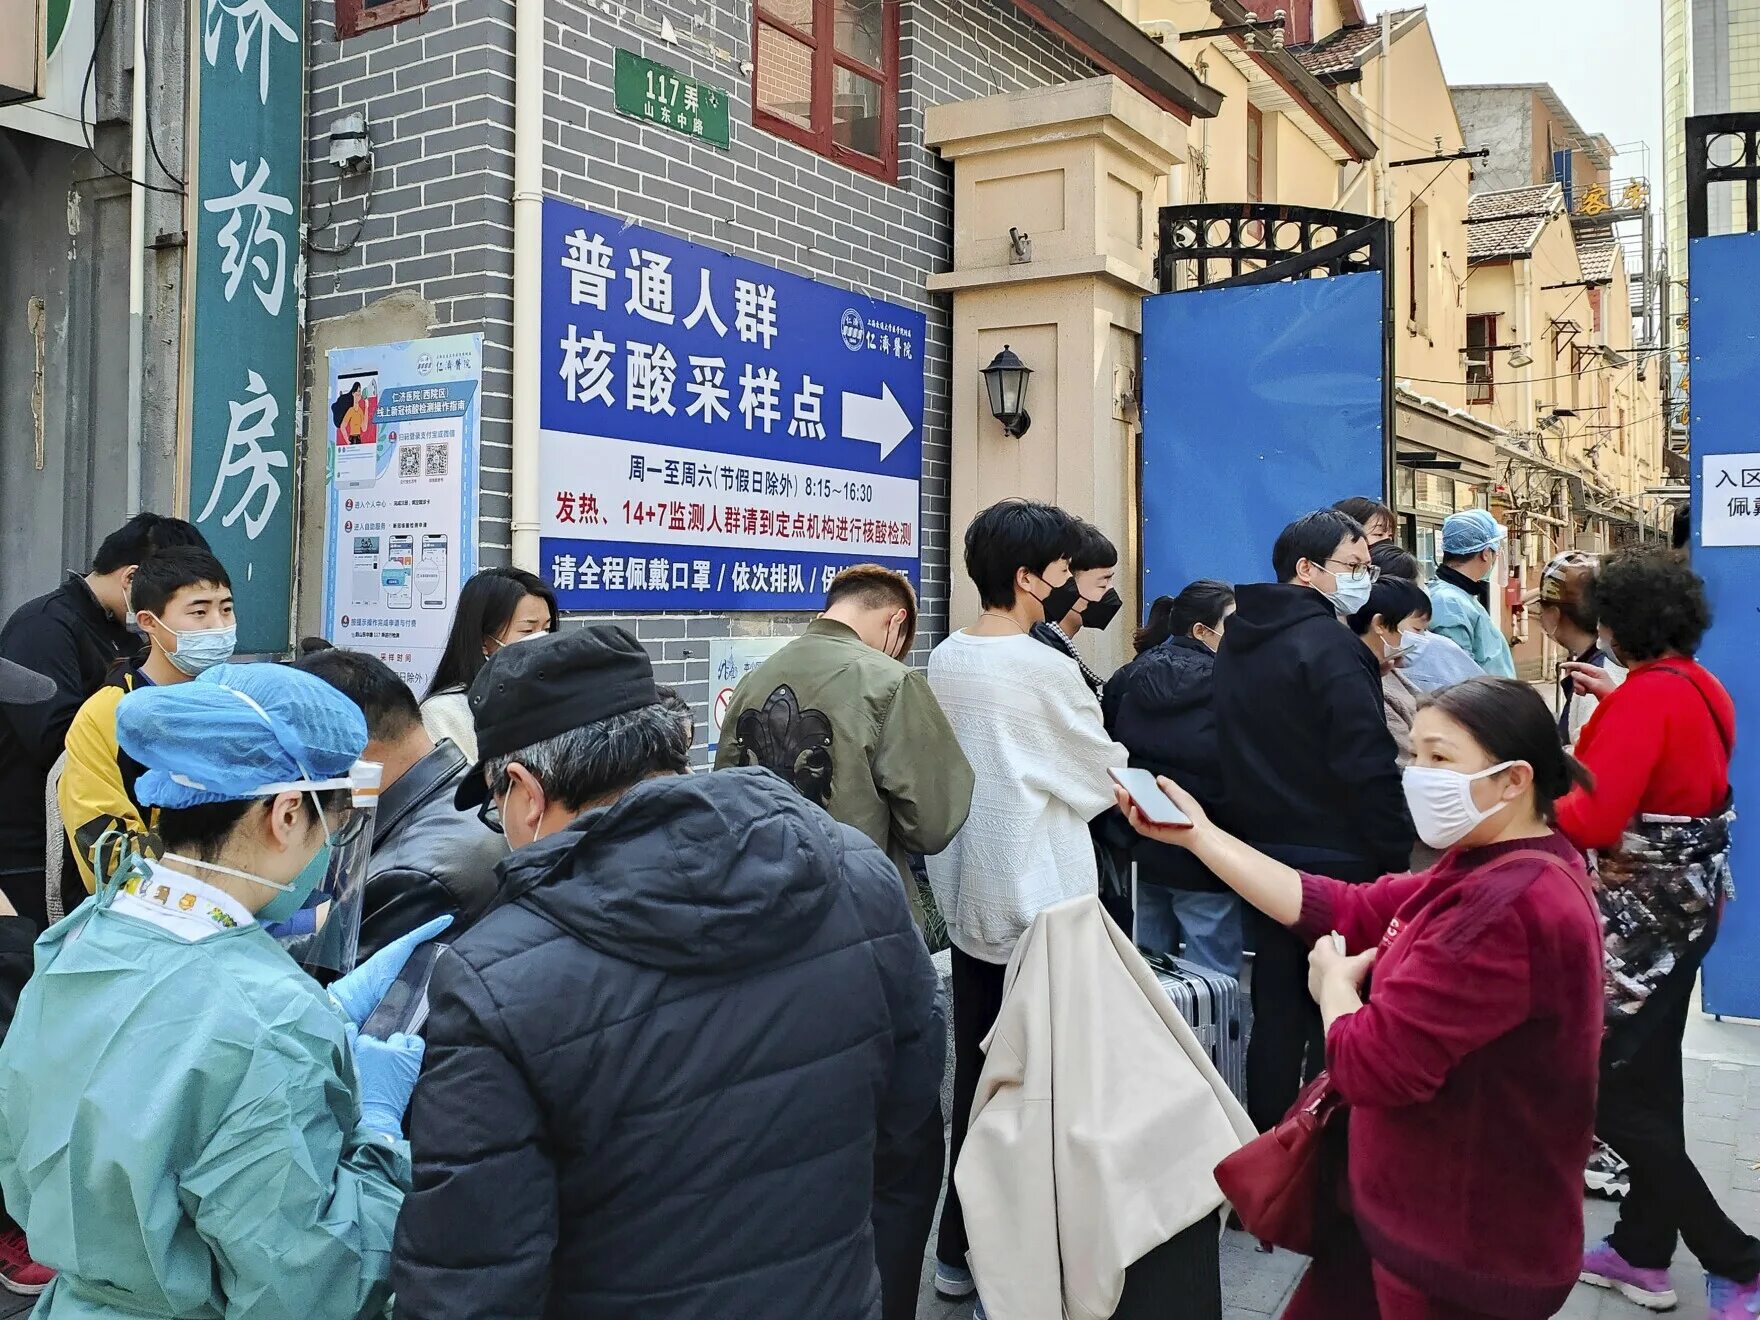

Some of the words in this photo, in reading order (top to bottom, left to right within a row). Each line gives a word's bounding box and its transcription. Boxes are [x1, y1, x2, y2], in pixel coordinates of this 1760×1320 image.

[646, 70, 699, 113] 117弄
[644, 100, 704, 135] 山东中路
[561, 229, 778, 349] 普通人群
[558, 323, 827, 441] 核酸采样点
[376, 400, 466, 417] 线上新冠核酸检测操作指南
[628, 454, 798, 498] 周一至周六(节假日除外)
[804, 476, 873, 502] 8:15~16:30
[555, 491, 912, 546] 发热、14+7监测人群请到定点机构进行核酸检测
[551, 554, 711, 592] 请全程佩戴口罩
[731, 561, 805, 594] 依次排队
[380, 653, 412, 662] 采样时间
